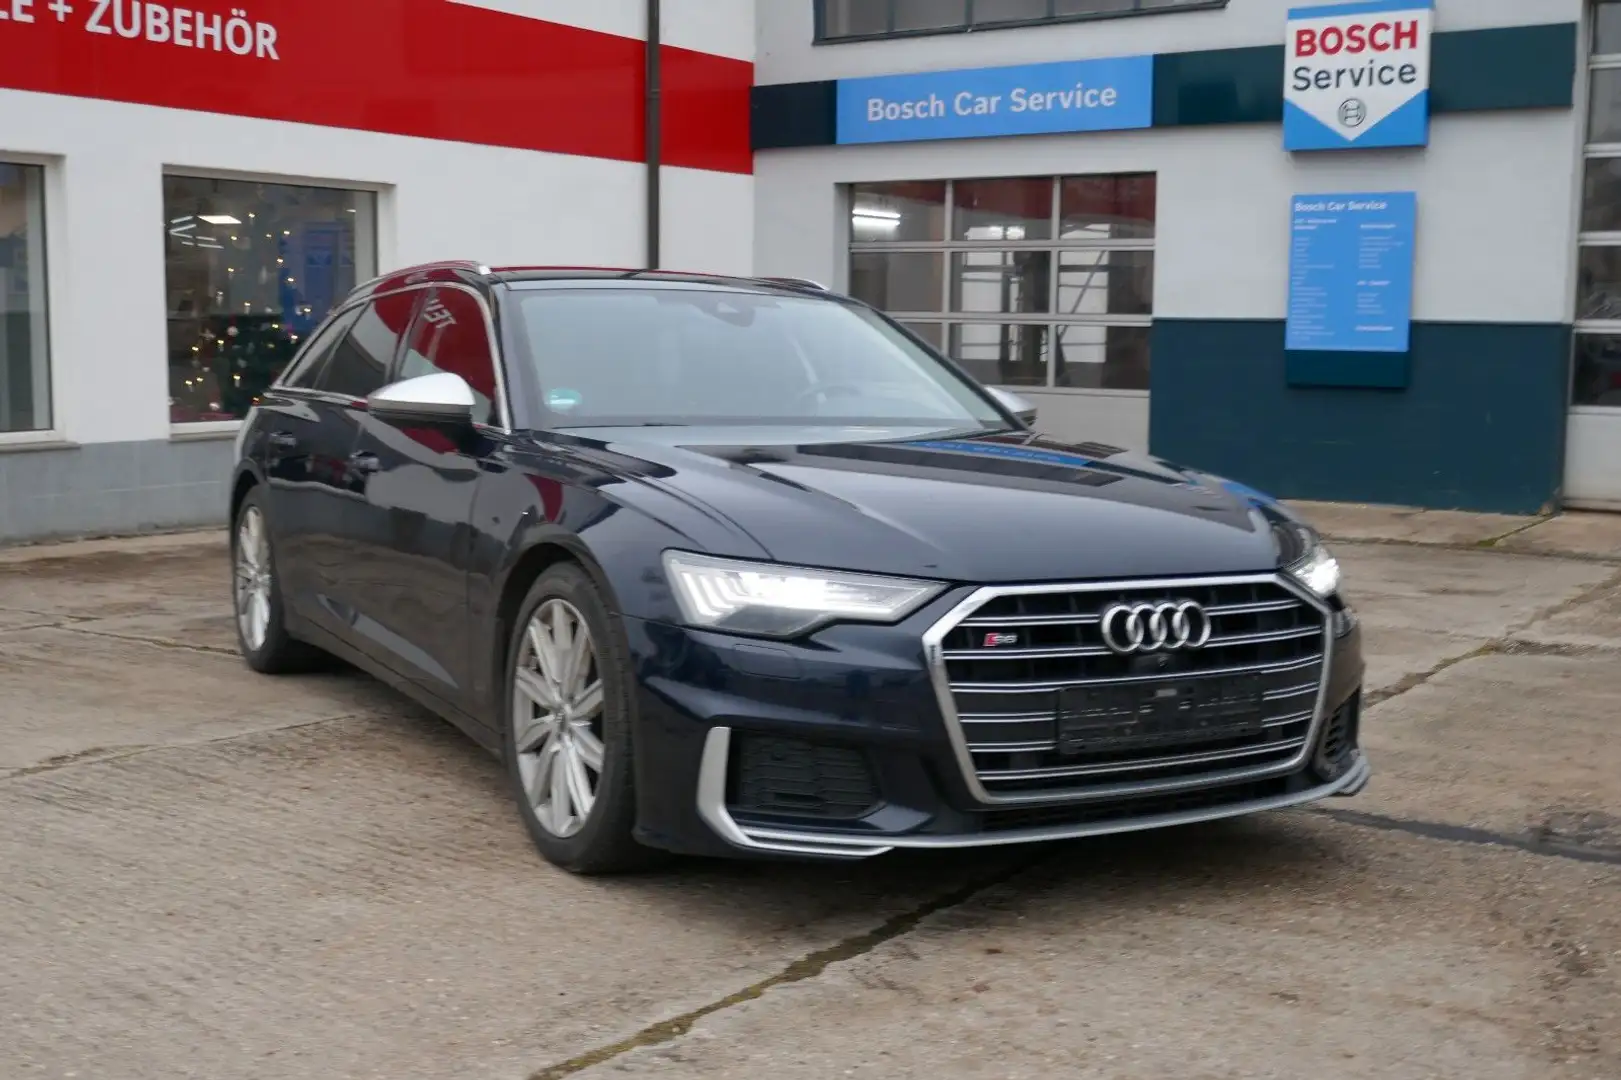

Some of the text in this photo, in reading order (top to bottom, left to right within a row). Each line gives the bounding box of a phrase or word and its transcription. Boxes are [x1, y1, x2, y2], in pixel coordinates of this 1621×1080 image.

[85, 0, 280, 60] ZUBEHÖR
[1295, 20, 1418, 57] BOSCH
[1293, 59, 1417, 92] Service
[867, 82, 1117, 121] Bosch Car Service
[1294, 200, 1388, 212] Bosch Car Service
